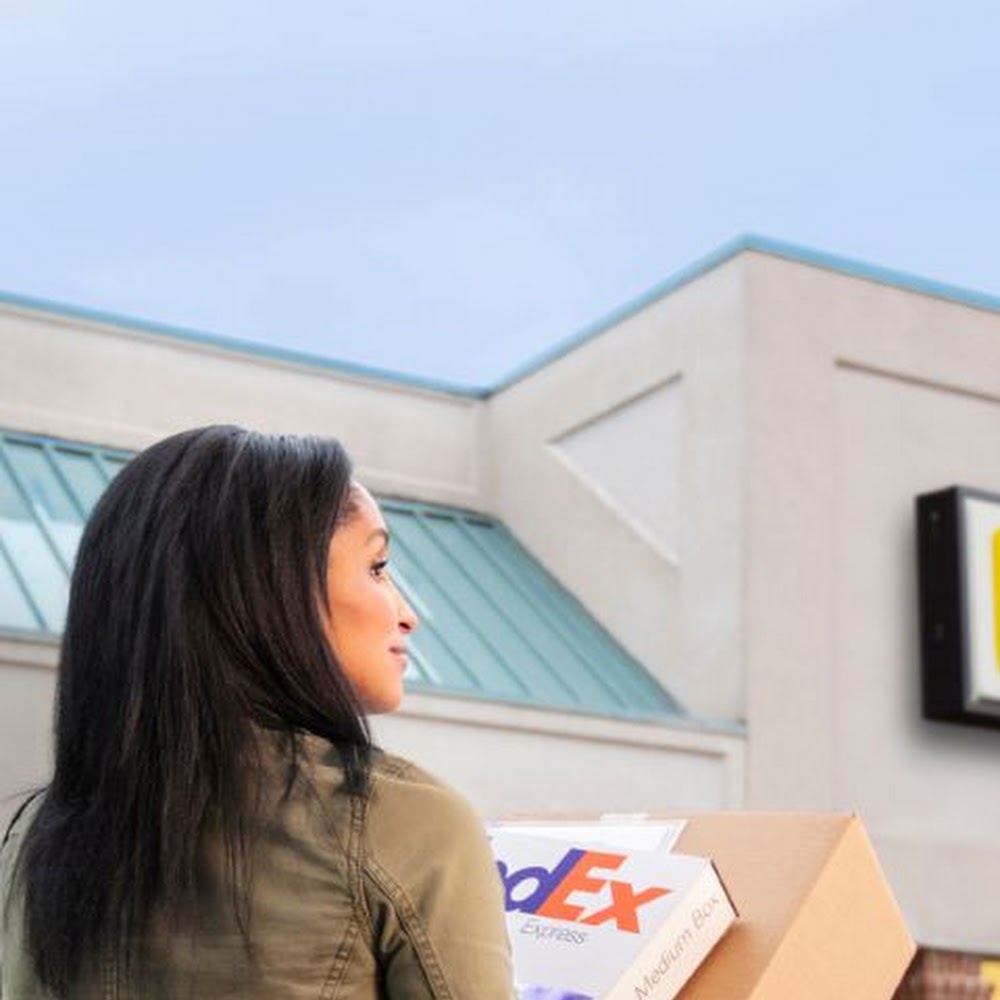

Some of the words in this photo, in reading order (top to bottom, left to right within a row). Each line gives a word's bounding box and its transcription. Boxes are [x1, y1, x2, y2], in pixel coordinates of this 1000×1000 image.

[496, 848, 672, 934] dEx
[691, 895, 720, 930] Box
[520, 917, 588, 945] Express
